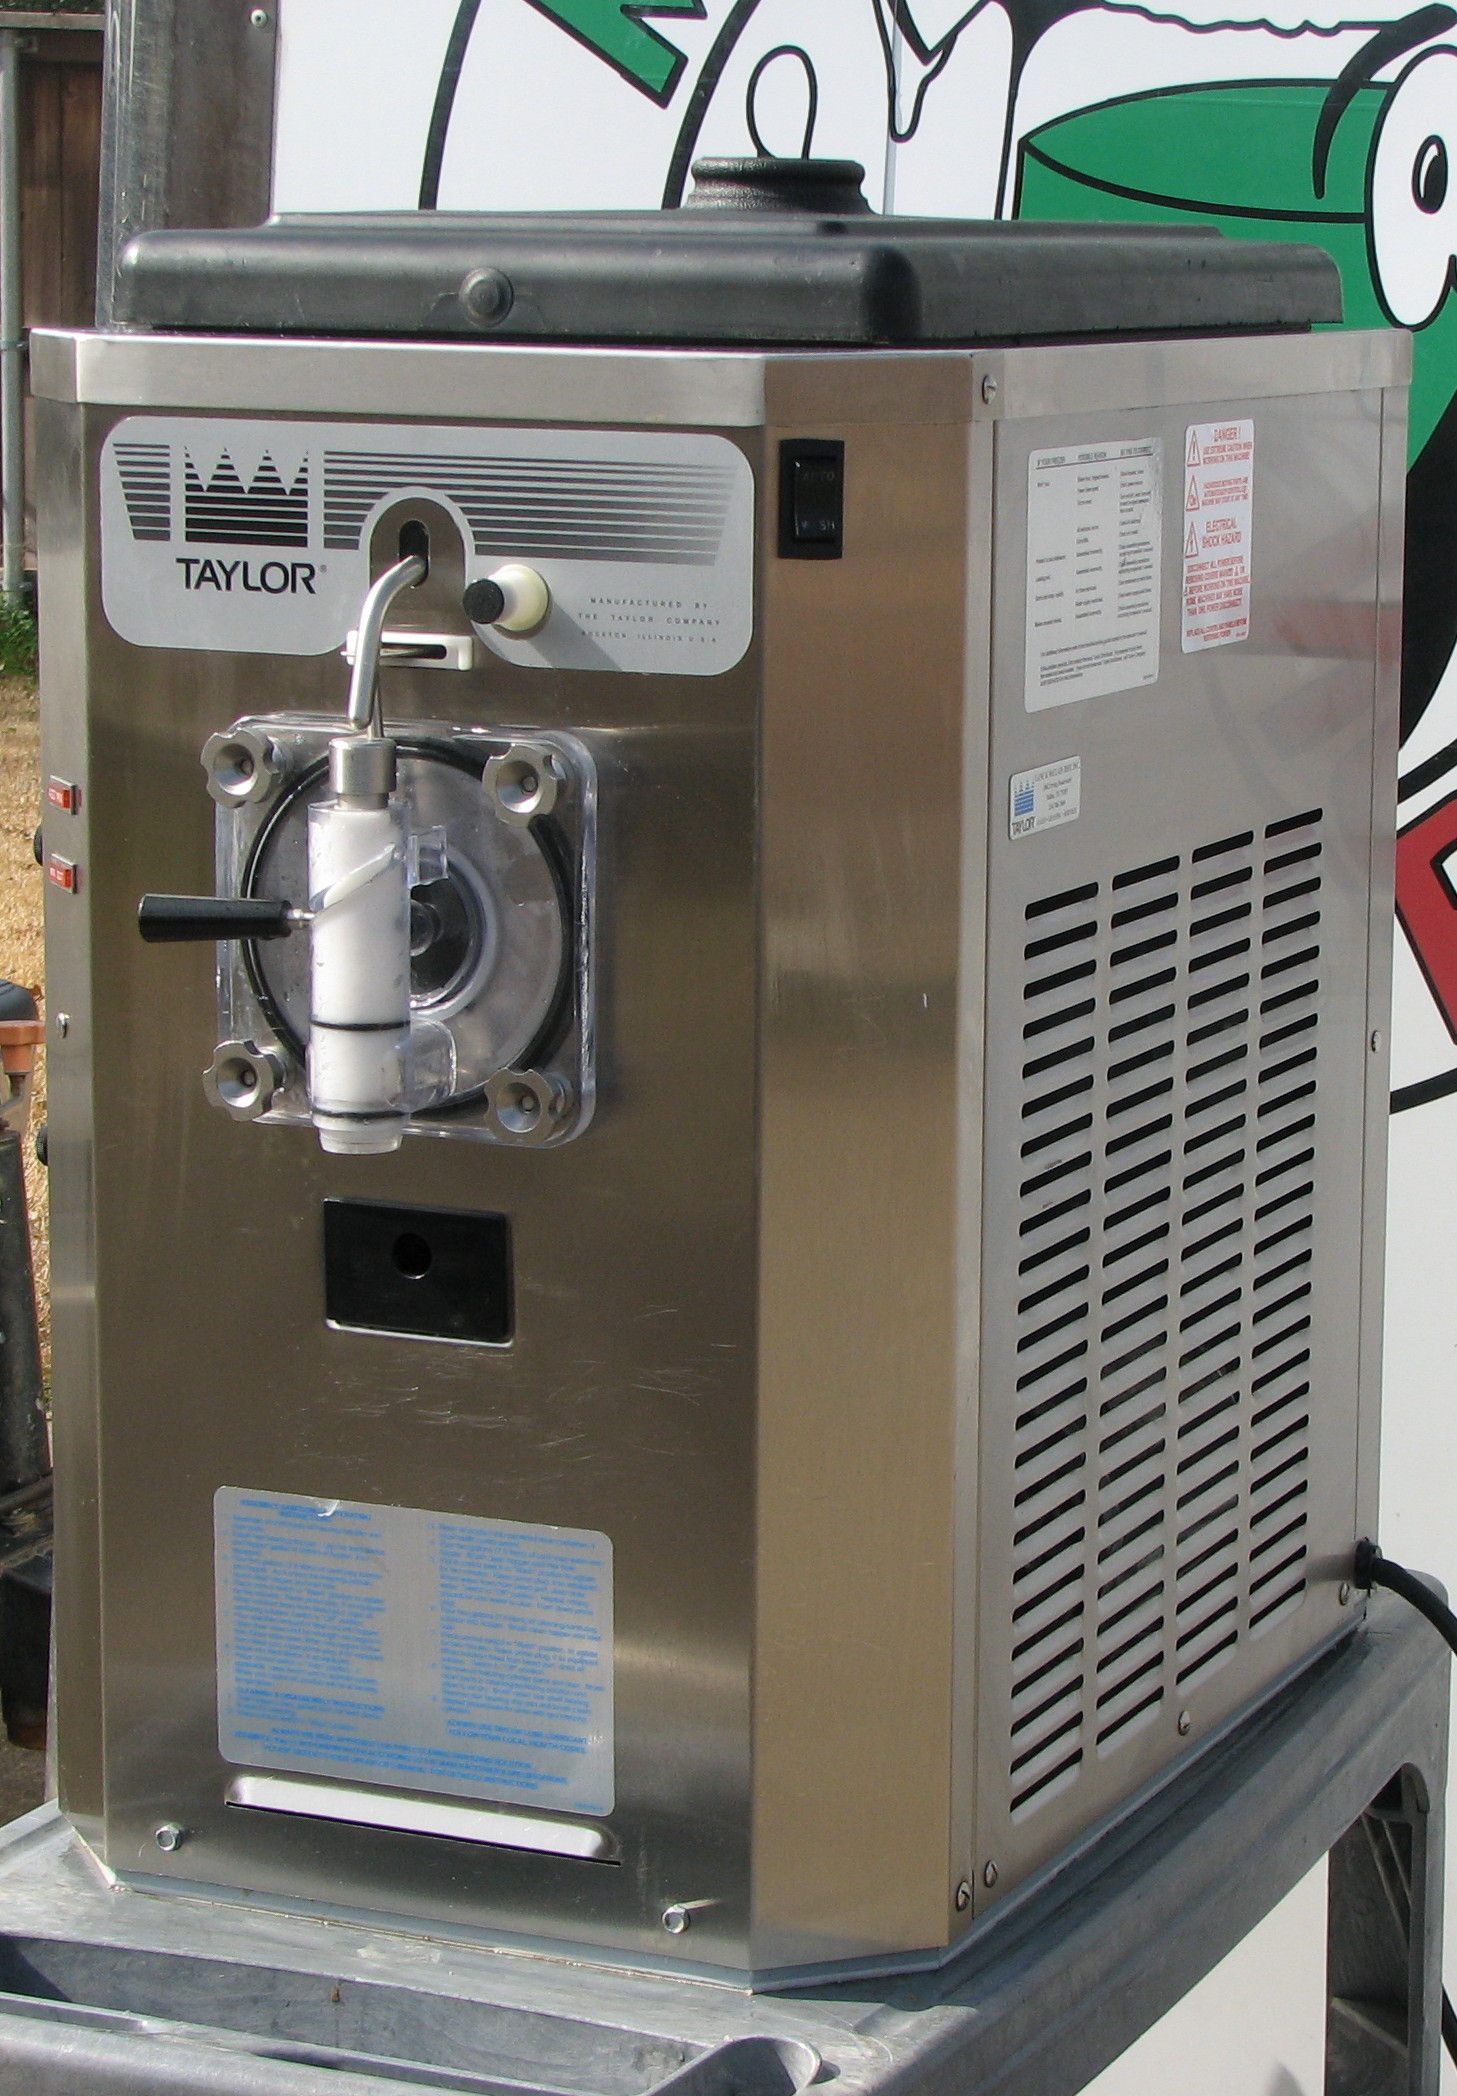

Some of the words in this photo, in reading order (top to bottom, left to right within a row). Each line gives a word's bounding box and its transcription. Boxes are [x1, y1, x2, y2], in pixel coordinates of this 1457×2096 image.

[801, 520, 835, 530] WSH
[175, 557, 317, 595] TAYLOR
[590, 597, 682, 608] MANUFACTURED
[695, 601, 708, 609] BY
[578, 612, 598, 621] THE
[611, 614, 654, 623] TAYLOR
[666, 617, 720, 627] COMPANY
[637, 633, 682, 642] ILLINOIS
